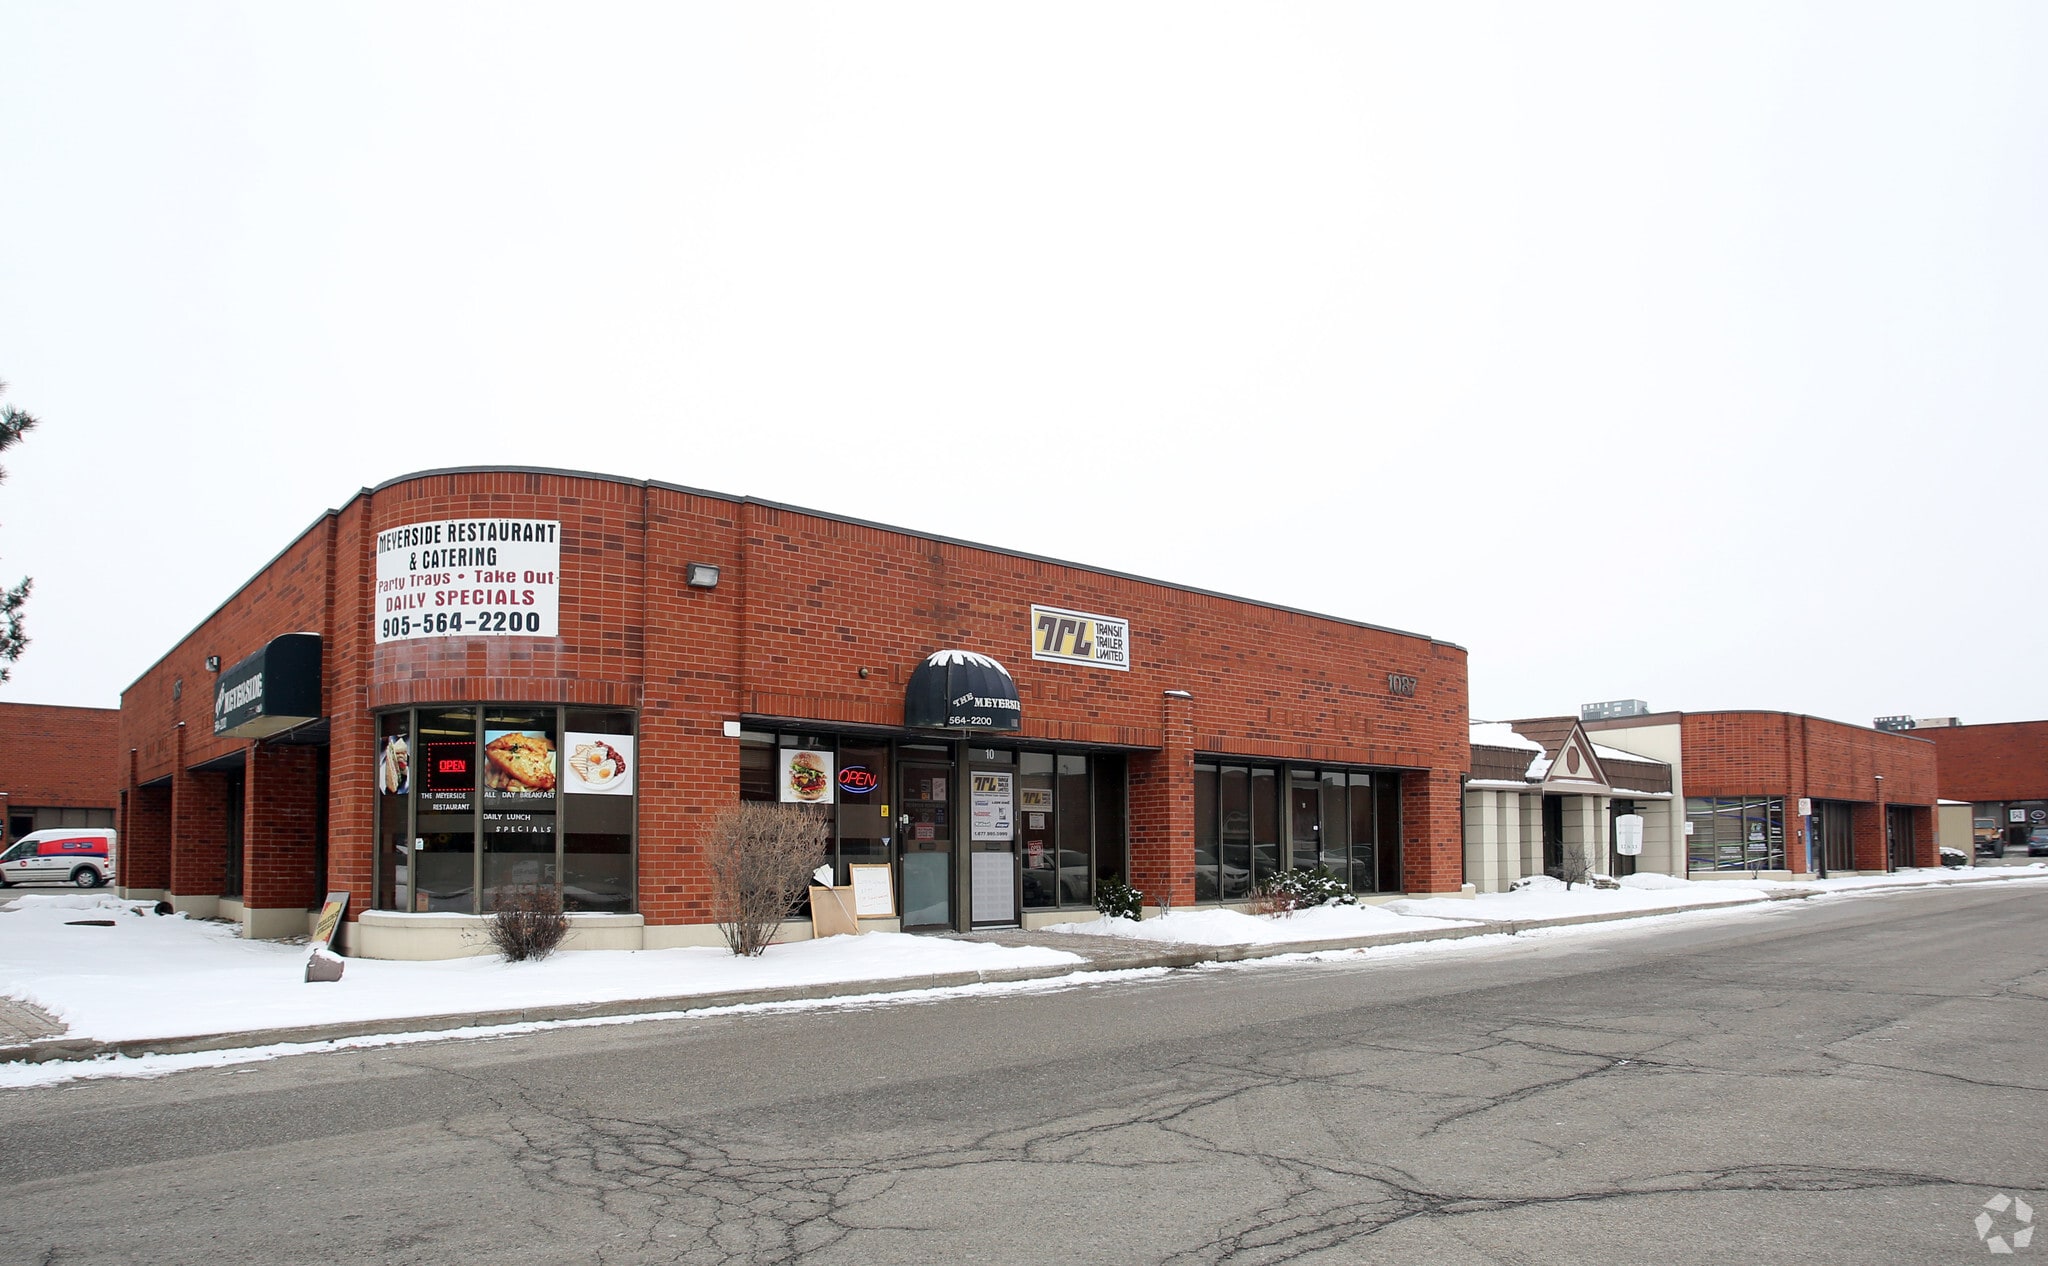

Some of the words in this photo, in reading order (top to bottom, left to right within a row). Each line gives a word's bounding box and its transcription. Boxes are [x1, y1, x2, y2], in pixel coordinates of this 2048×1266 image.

[378, 524, 442, 554] MEYERSIDE
[447, 522, 556, 543] RESTAURANT
[409, 552, 417, 571] &
[422, 547, 497, 569] CATERING
[378, 577, 405, 593] Party
[410, 572, 451, 587] Trays
[474, 569, 517, 584] Take
[523, 570, 554, 584] Out
[386, 592, 427, 612] DAILY
[435, 589, 535, 606] SPECIALS
[382, 611, 540, 638] 905-564-2200
[1095, 622, 1123, 638] TRANSIT
[1095, 635, 1123, 650] TRAILER
[1095, 648, 1124, 662] LIMITED
[1388, 674, 1417, 697] 1087
[952, 692, 974, 707] THE
[949, 716, 992, 725] 564-2200
[985, 749, 995, 760] 10
[439, 760, 466, 771] OPEN
[838, 769, 877, 786] OPEN
[519, 791, 556, 799] BREAKFAST
[495, 825, 552, 833] SPECIALS
